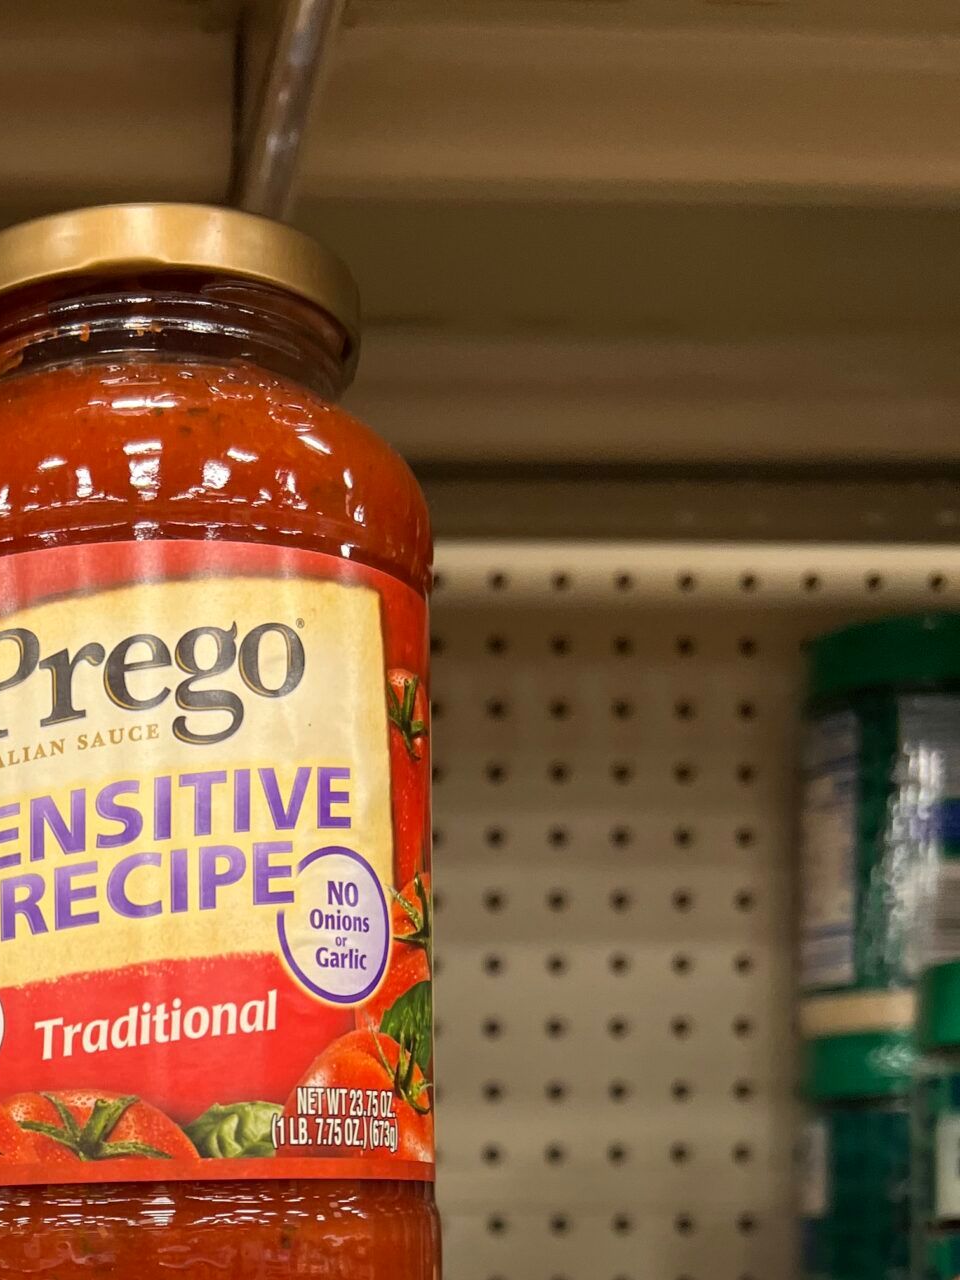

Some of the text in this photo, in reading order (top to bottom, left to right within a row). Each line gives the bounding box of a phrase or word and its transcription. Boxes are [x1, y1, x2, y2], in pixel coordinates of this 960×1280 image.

[76, 723, 159, 751] SAUCE
[0, 840, 296, 941] RECIPE
[327, 880, 359, 907] NO
[309, 908, 370, 933] Onions
[335, 936, 348, 947] or
[315, 947, 367, 970] Garlic
[34, 989, 277, 1061] Traditional
[297, 1087, 396, 1118] NET WT 23.75 OZ.
[272, 1114, 398, 1152] (1 LB. 7.75 OZ.) (673g)
